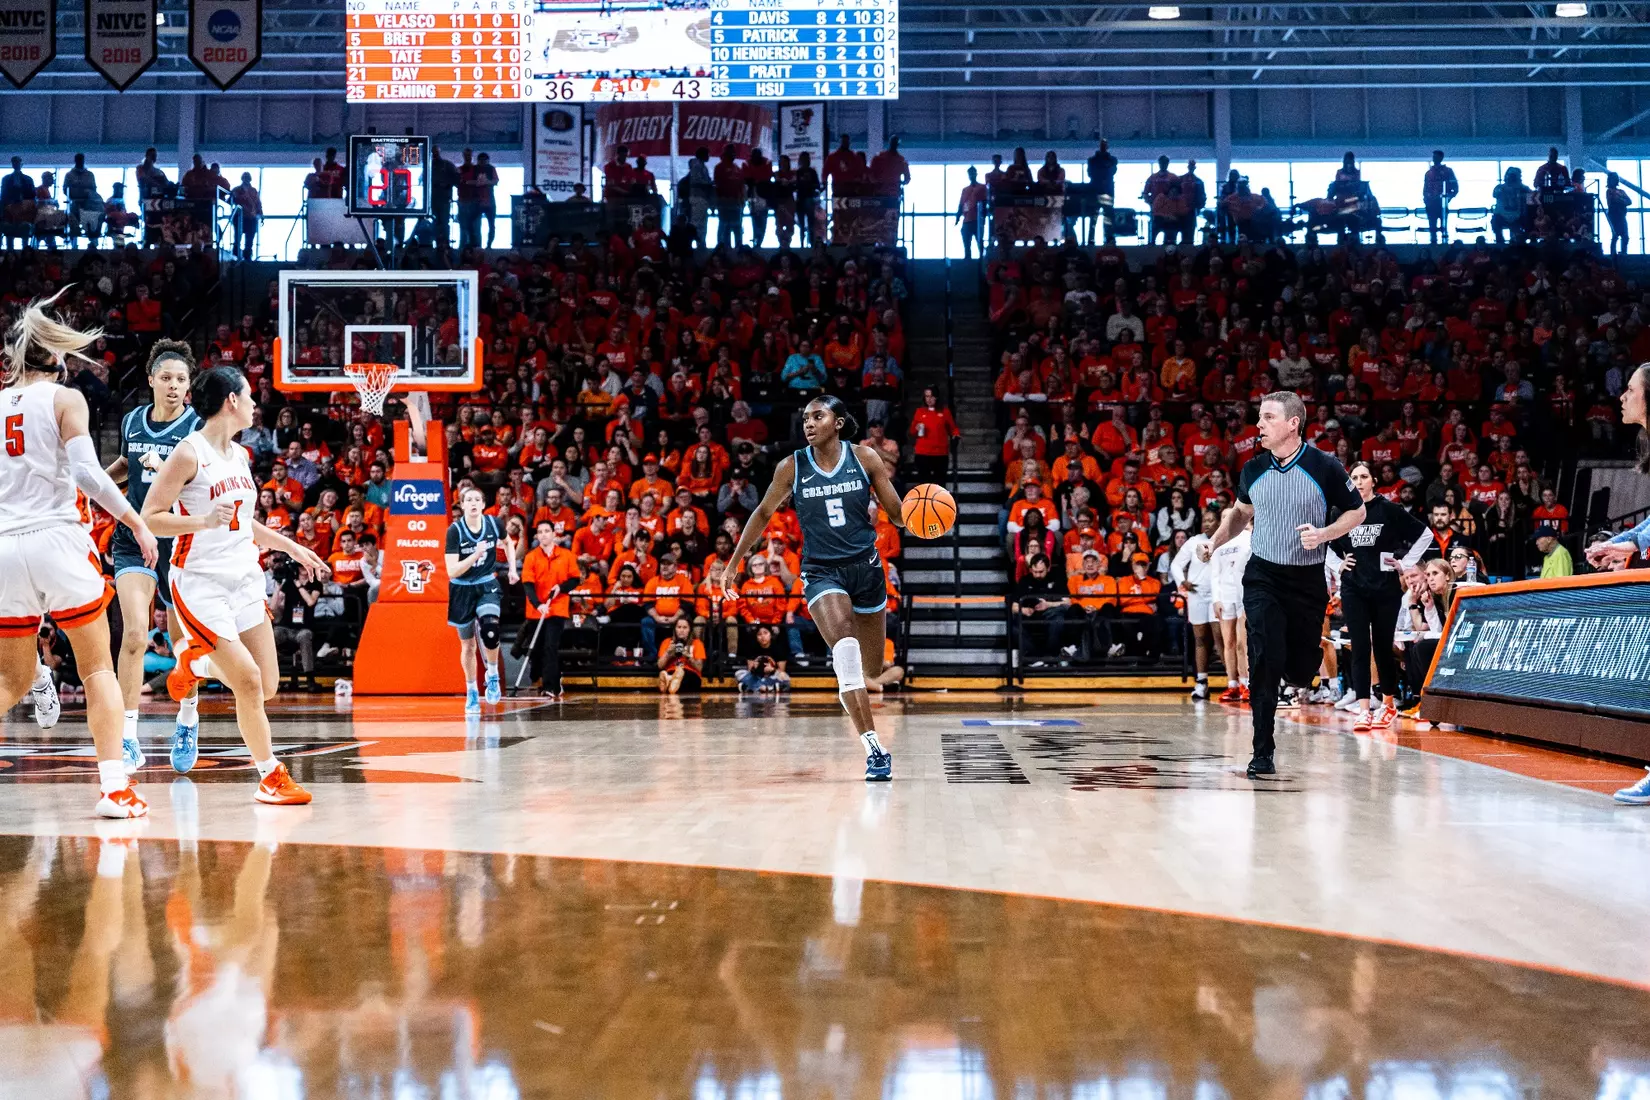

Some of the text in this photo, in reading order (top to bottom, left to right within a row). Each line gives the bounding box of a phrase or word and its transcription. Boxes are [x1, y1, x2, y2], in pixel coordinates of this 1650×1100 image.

[348, 2, 365, 11] NO
[385, 1, 419, 10] NAME
[454, 1, 460, 10] P
[473, 1, 480, 10] A
[491, 1, 497, 9] R
[509, 1, 515, 10] S
[97, 13, 146, 29] NIVC
[352, 15, 531, 27] 1 VELASCO 11 1 0 1 0
[713, 11, 895, 25] 4 DAVIS 8 4 10 3 2
[351, 32, 531, 45] 5 BRETT 8 0 2 1 1
[714, 28, 895, 43] 5 PATRICK 3 2 1 0 2
[1, 46, 40, 60] 2018
[103, 48, 141, 63] 2019
[203, 48, 248, 62] 2020
[349, 50, 531, 63] 11 TATE 5 1 4 0 2
[712, 46, 895, 61] 10 HENDERSON 5 2 4 0 1
[349, 68, 532, 81] 21 DAY 1 0 1 0 0
[712, 64, 895, 79] 12 PRATT 9 1 4 0 1
[347, 85, 532, 98] 25 FLEMING 7 2 4 1 0
[545, 81, 574, 100] 36
[600, 80, 644, 92] 9:10
[672, 80, 700, 99] 43
[711, 82, 896, 96] 35 HSU 14 1 2 1 2
[621, 115, 672, 143] ZIGGY
[683, 115, 752, 145] ZOOMBA
[368, 168, 412, 205] 27
[5, 413, 25, 457] 5
[802, 479, 864, 498] COLUMBIA
[394, 484, 441, 510] Kroger
[824, 497, 847, 527] 5
[407, 520, 427, 531] GO
